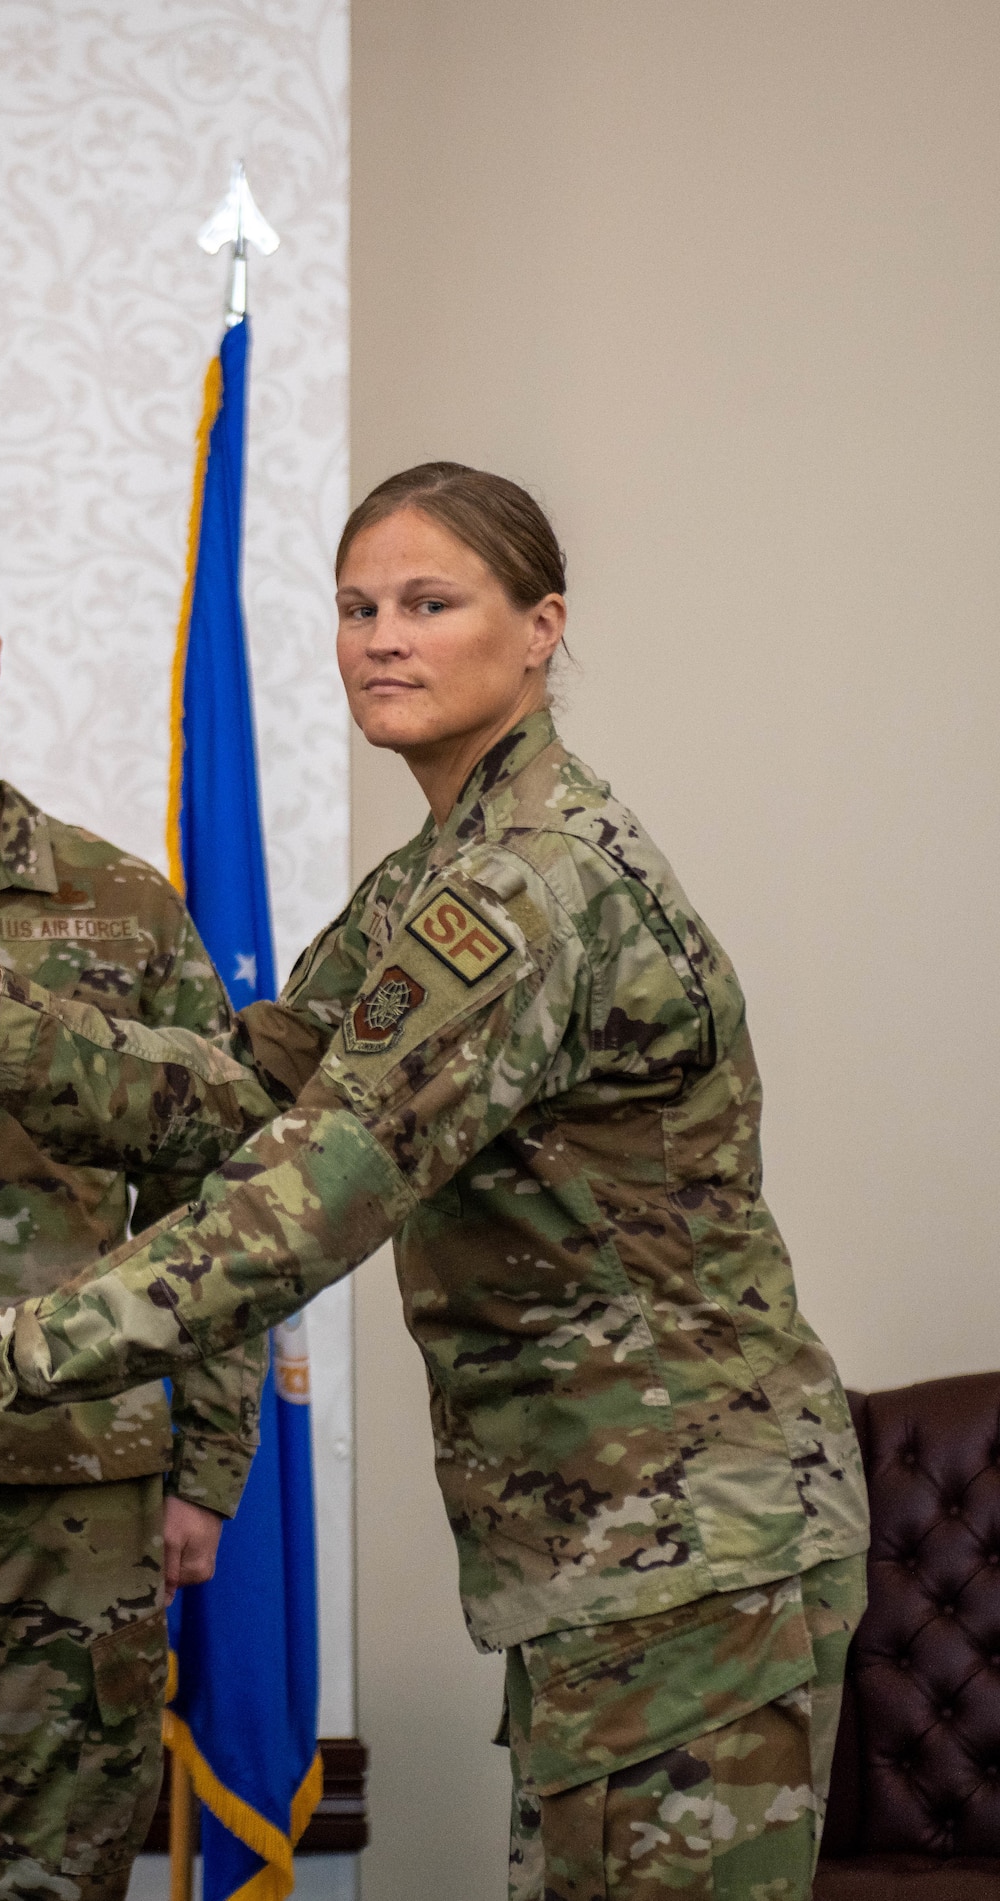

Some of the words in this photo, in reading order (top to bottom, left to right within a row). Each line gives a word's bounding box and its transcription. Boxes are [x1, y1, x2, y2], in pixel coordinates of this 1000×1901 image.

[41, 921, 70, 938] AIR
[74, 920, 132, 938] FORCE
[423, 904, 500, 962] SF
